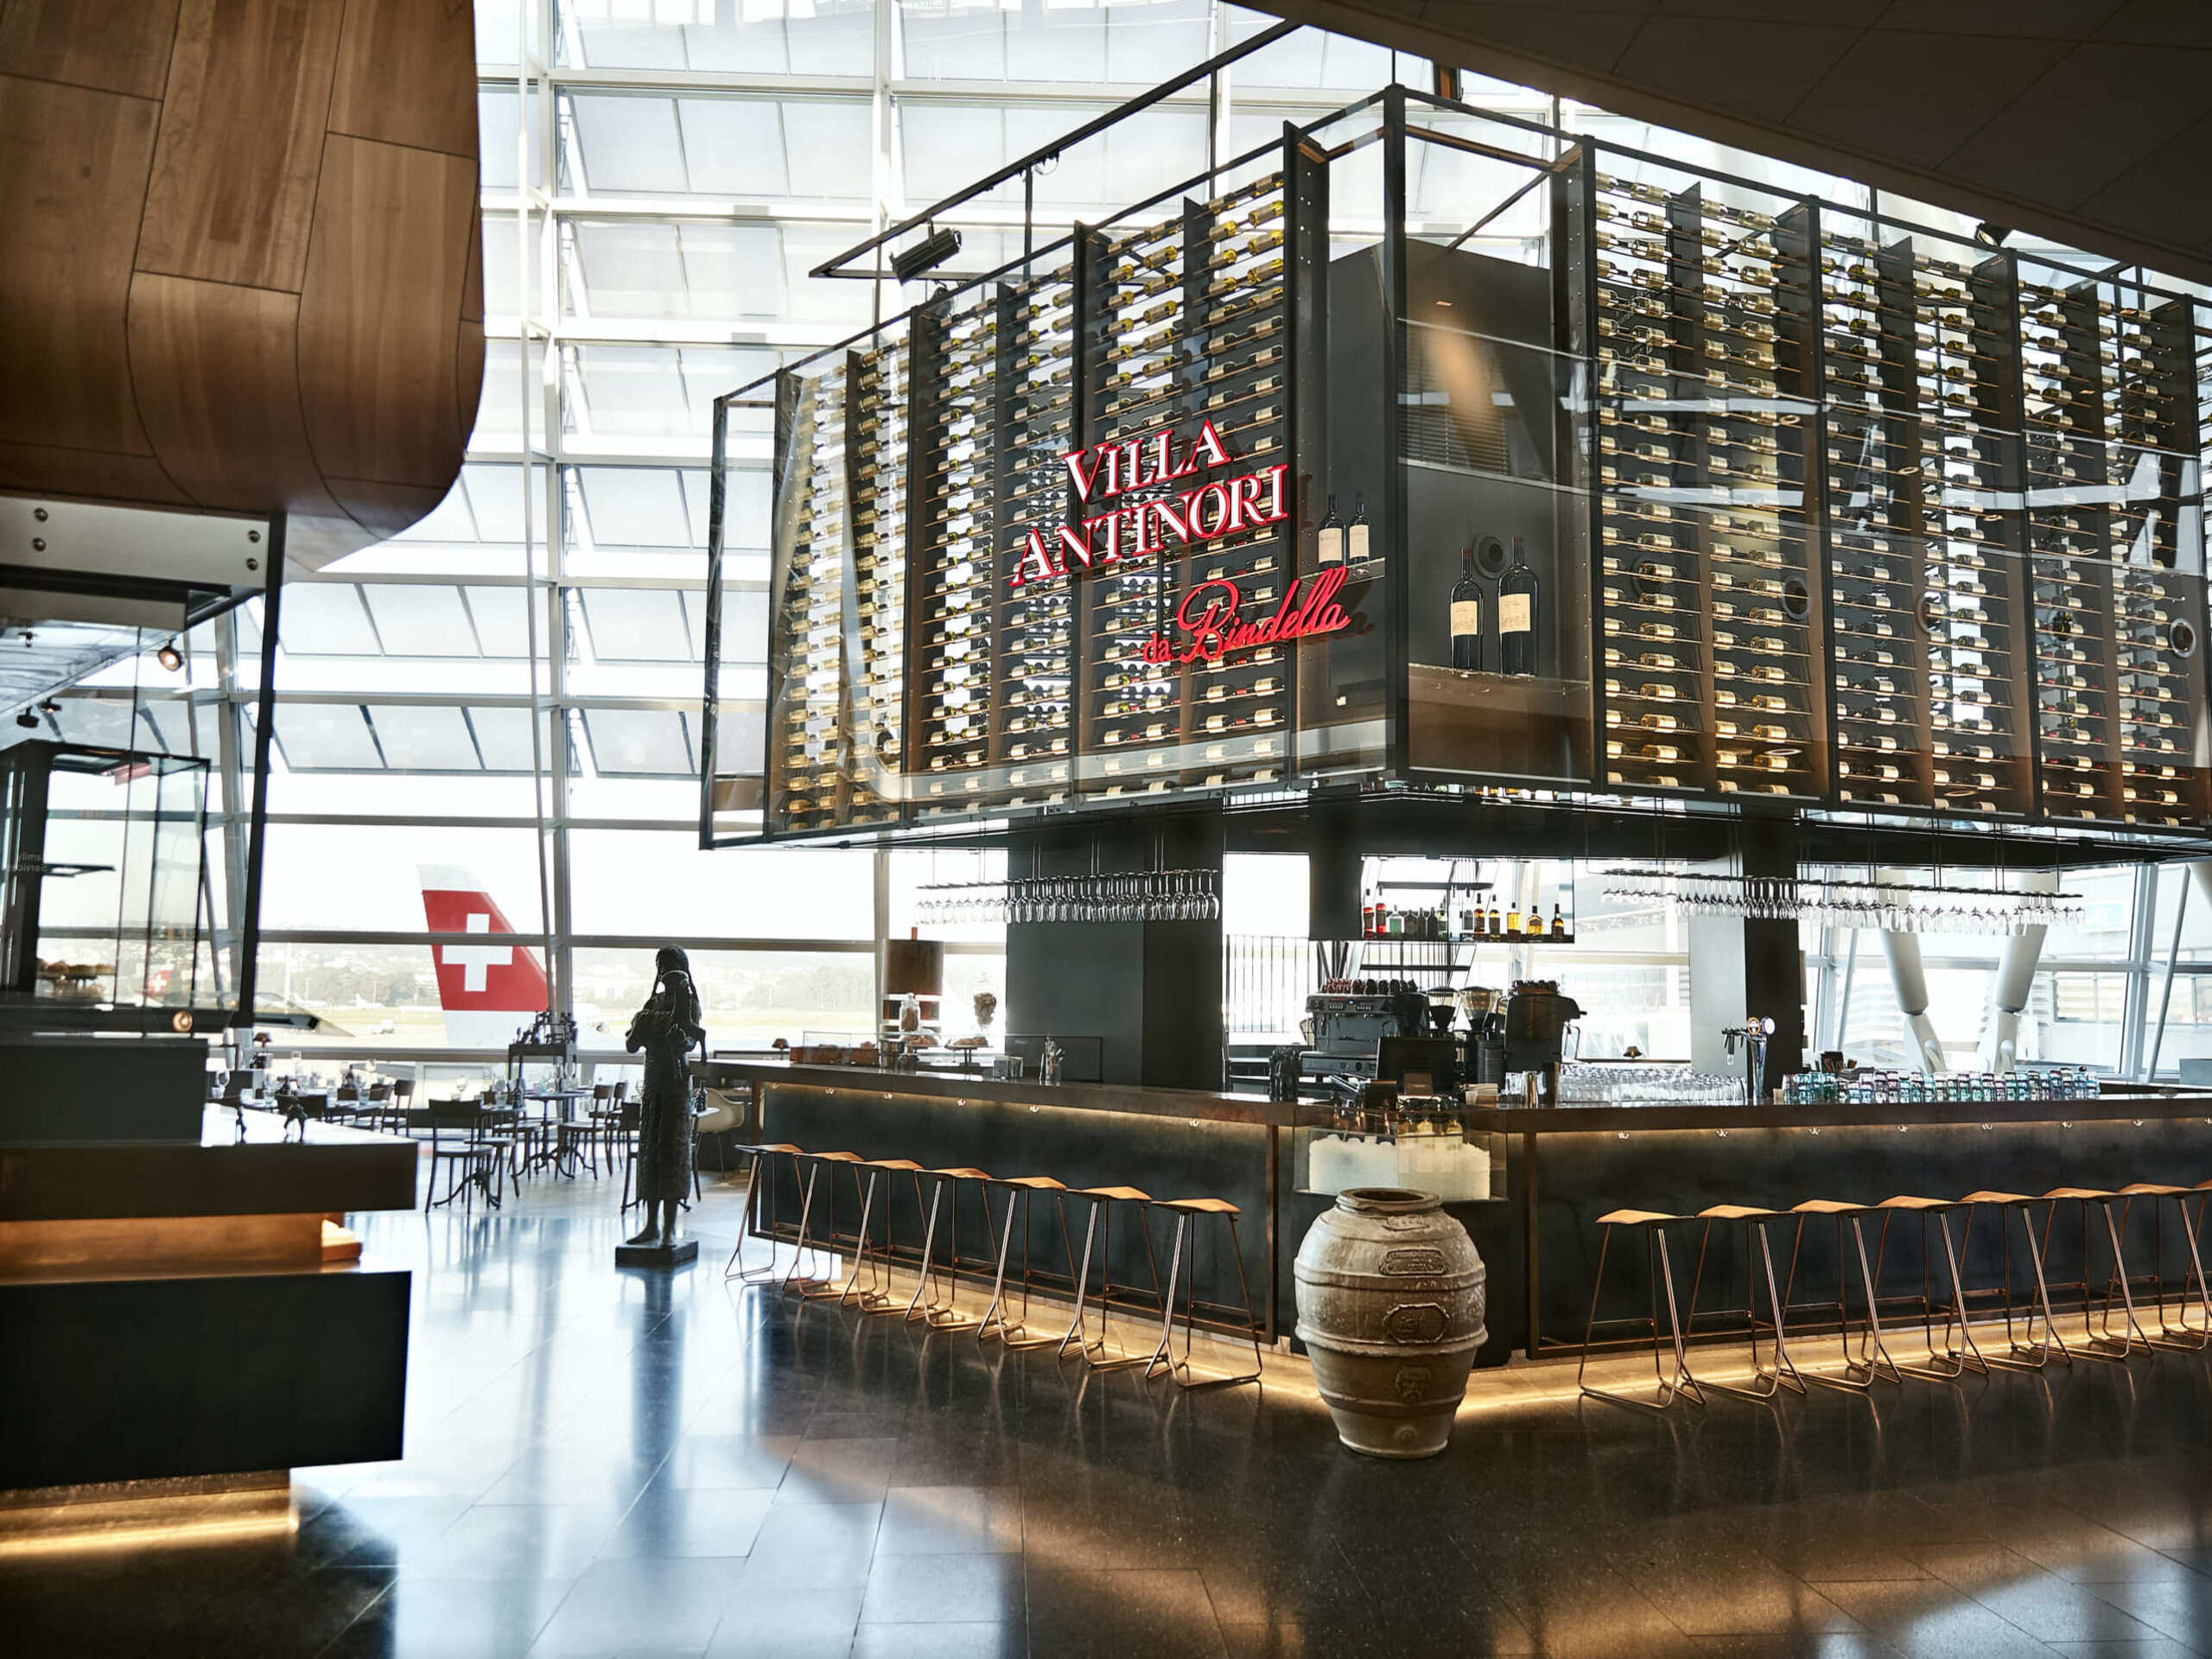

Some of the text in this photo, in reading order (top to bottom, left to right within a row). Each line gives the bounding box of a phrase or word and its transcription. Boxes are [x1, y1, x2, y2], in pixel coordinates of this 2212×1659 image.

[1062, 419, 1232, 504] VILLA
[1009, 464, 1289, 587] ANTINORI
[1142, 565, 1352, 664] da Bindella
